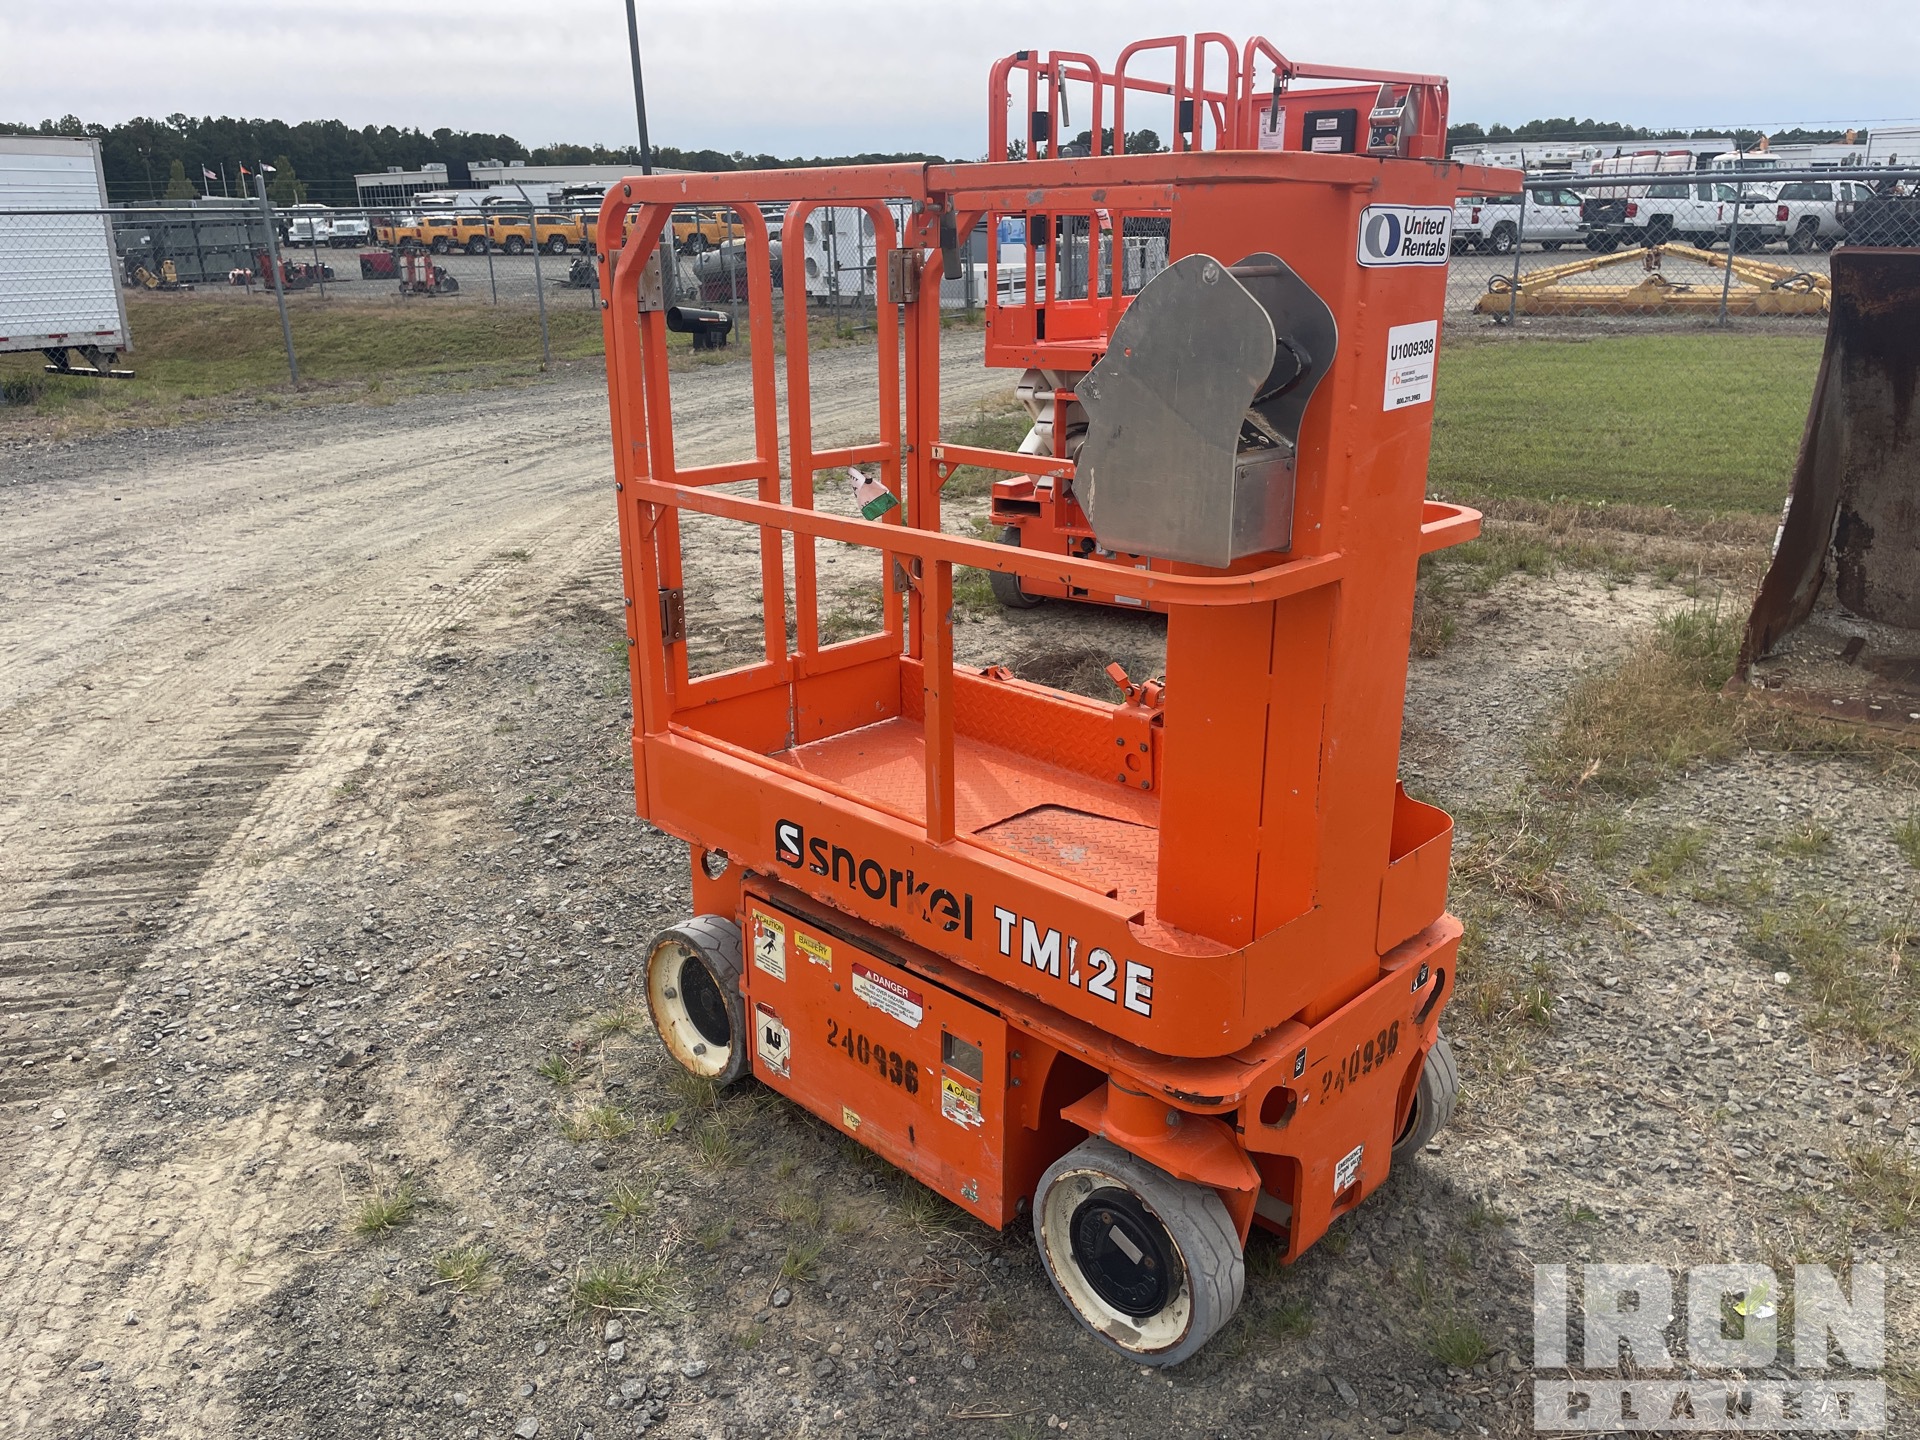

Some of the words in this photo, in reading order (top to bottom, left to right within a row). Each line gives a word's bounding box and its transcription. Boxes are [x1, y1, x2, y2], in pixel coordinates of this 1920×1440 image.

[1404, 216, 1446, 235] United
[1401, 237, 1446, 256] Rentals
[1391, 339, 1434, 360] U1009398
[809, 837, 973, 941] snorkel
[759, 915, 784, 933] CAUTION
[798, 935, 828, 956] BATTERY
[994, 905, 1154, 1019] TM12E
[873, 972, 909, 998] DANGER
[827, 1018, 918, 1094] 240936
[1320, 1020, 1399, 1105] 240936
